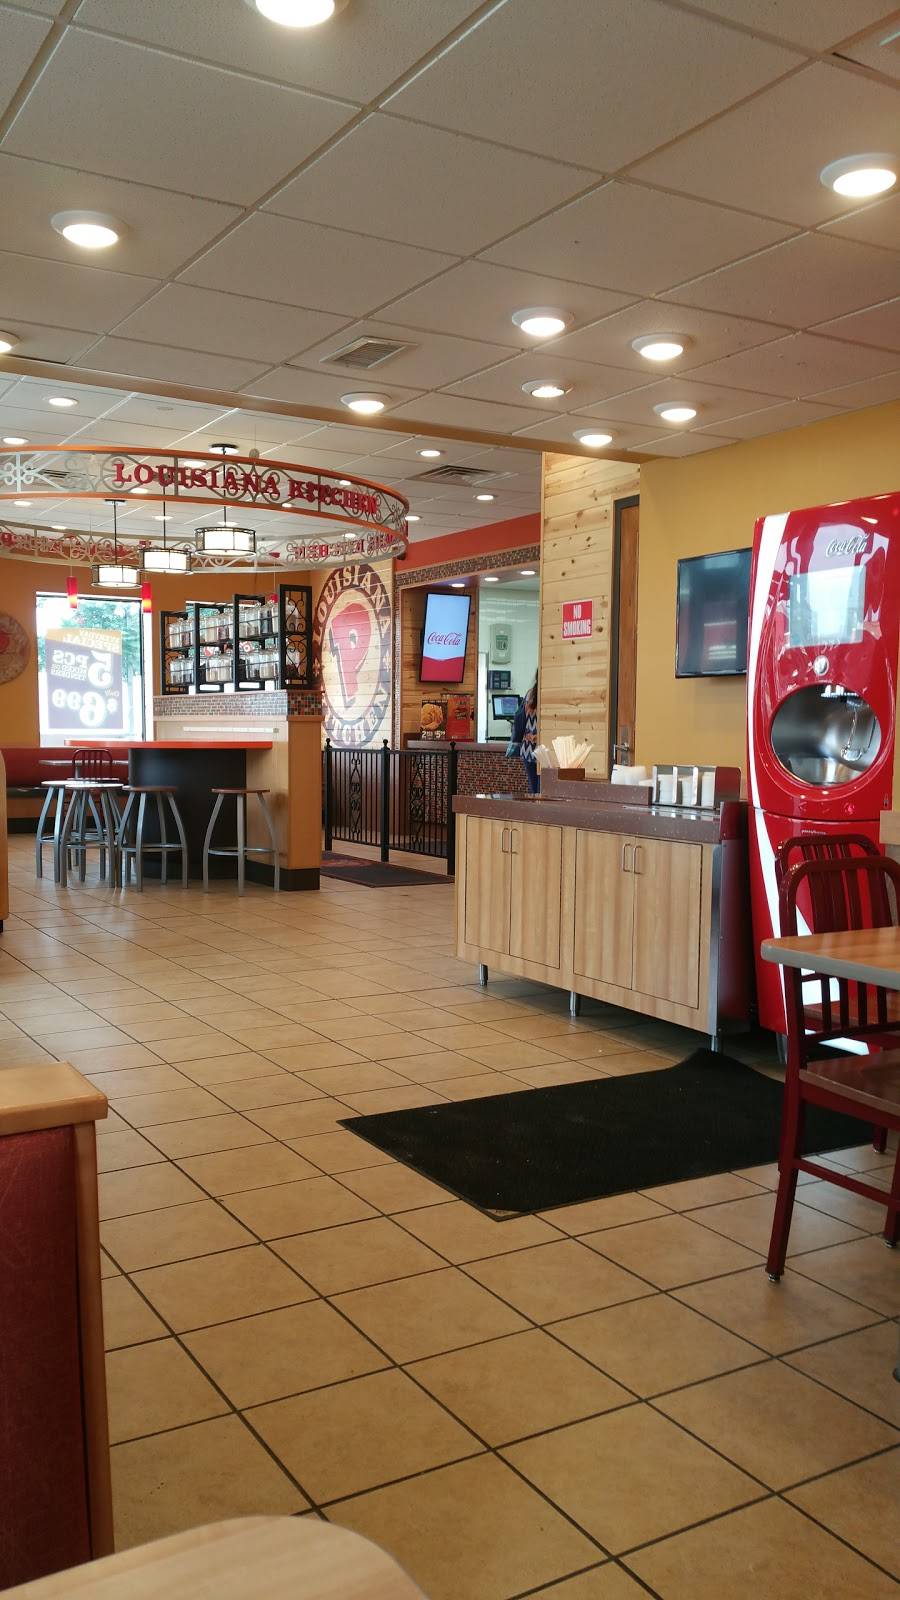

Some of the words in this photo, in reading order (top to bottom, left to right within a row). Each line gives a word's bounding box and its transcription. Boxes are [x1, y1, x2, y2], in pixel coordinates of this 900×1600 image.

[113, 463, 281, 496] LOUISIANA
[287, 479, 378, 515] KITCHEN
[312, 565, 391, 645] LOUISIANA
[427, 631, 463, 646] Coca-Cola
